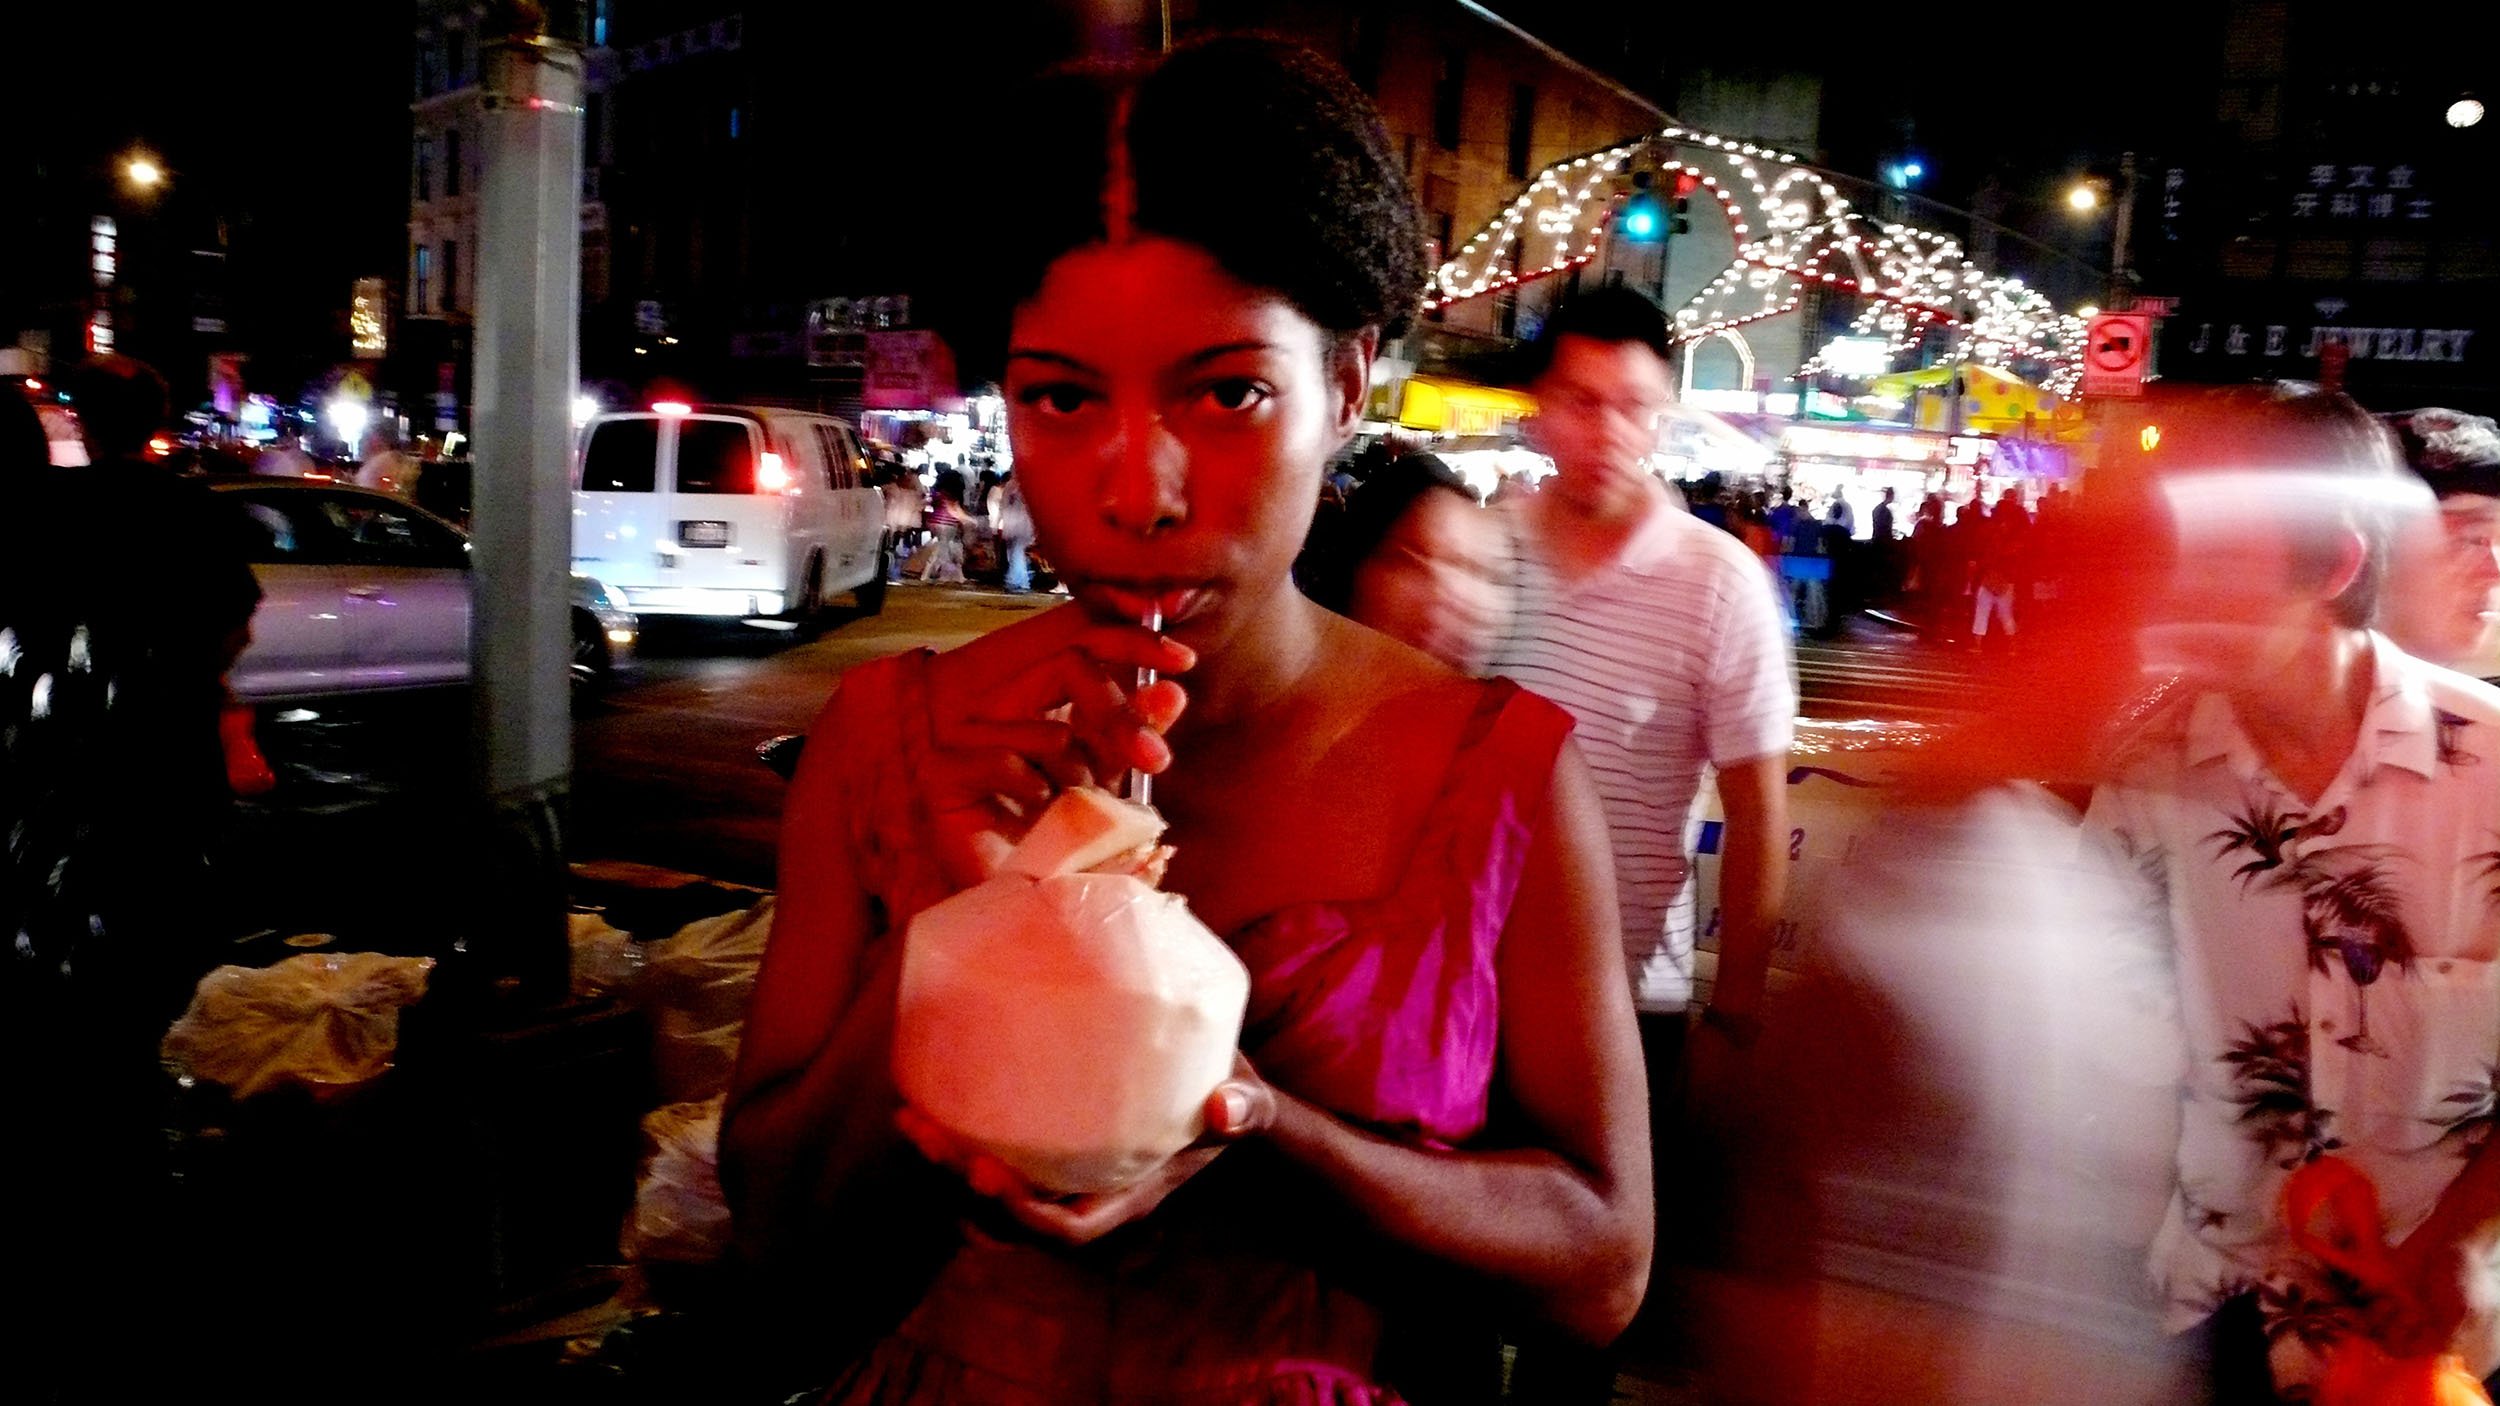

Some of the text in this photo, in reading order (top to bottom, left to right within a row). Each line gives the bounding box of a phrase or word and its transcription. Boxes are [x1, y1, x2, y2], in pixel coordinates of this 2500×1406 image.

[2188, 322, 2213, 354] J
[2223, 323, 2251, 355] &
[2263, 324, 2289, 356] E
